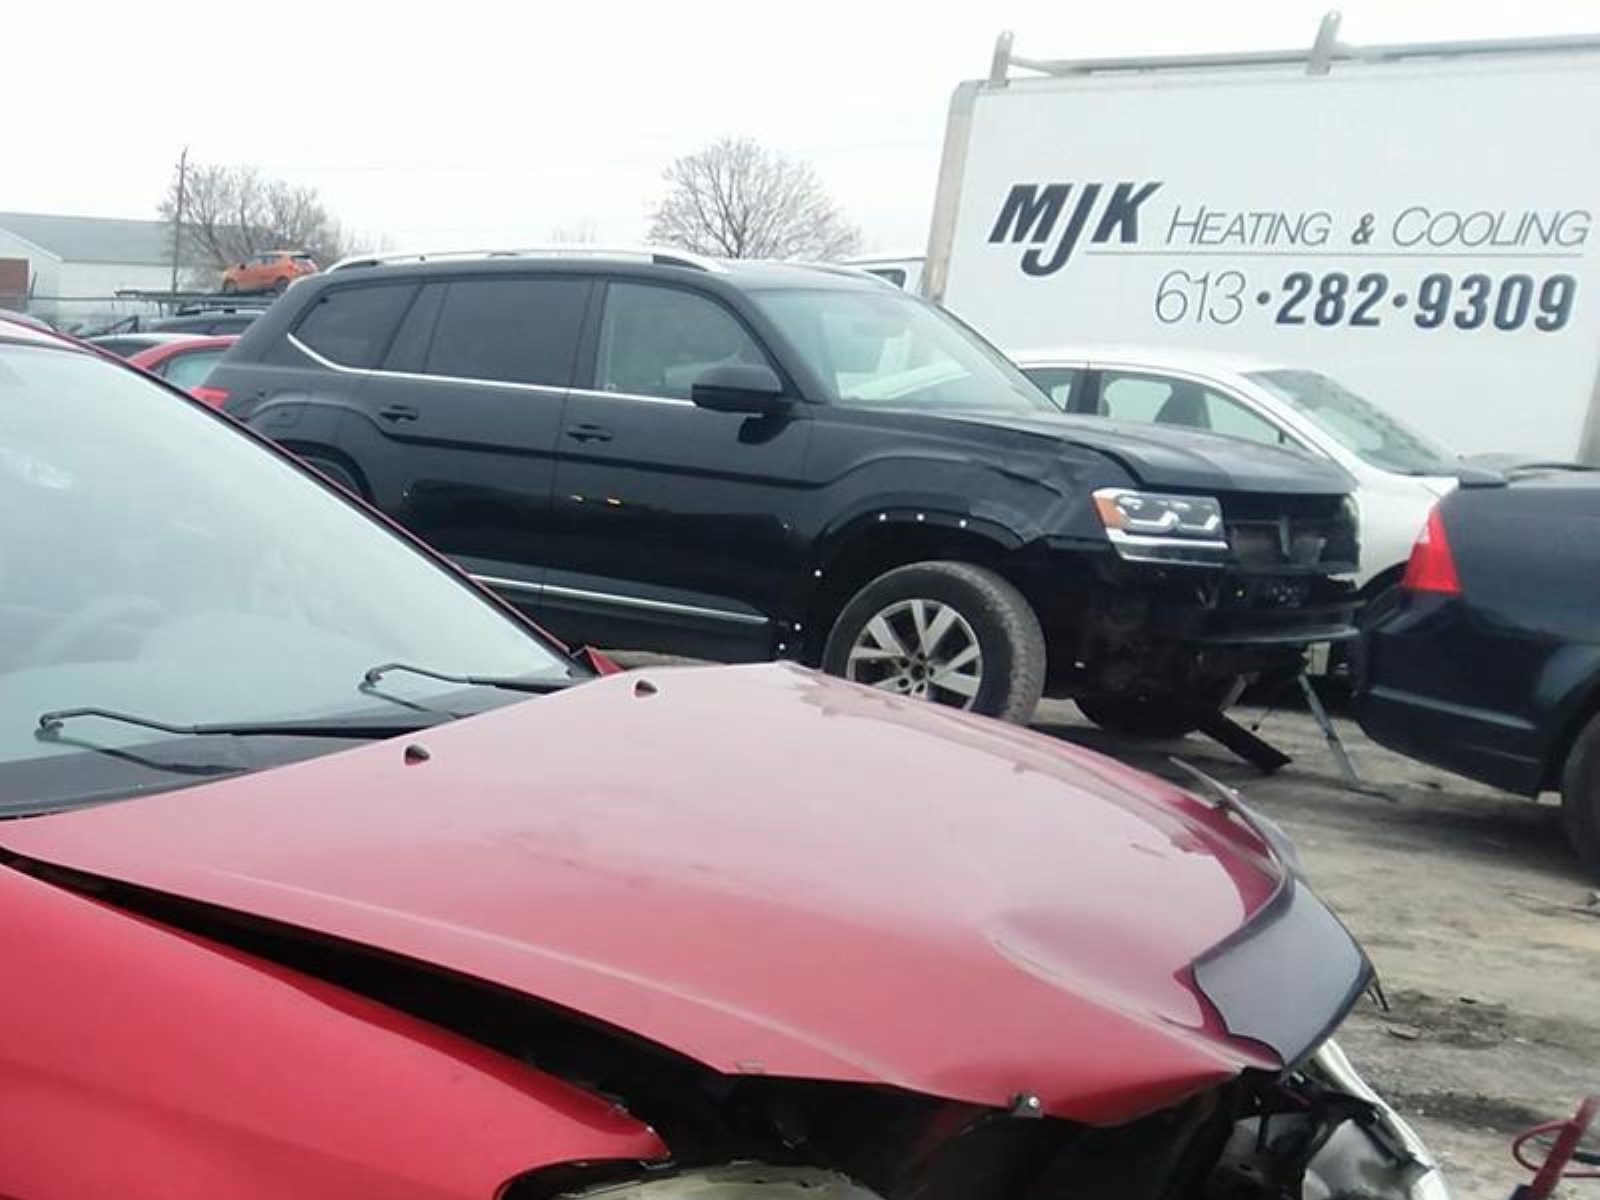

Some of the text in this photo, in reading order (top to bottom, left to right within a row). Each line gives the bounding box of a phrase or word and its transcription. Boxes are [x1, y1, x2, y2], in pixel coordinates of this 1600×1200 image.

[987, 181, 1592, 278] MJK HEATING & COOLING
